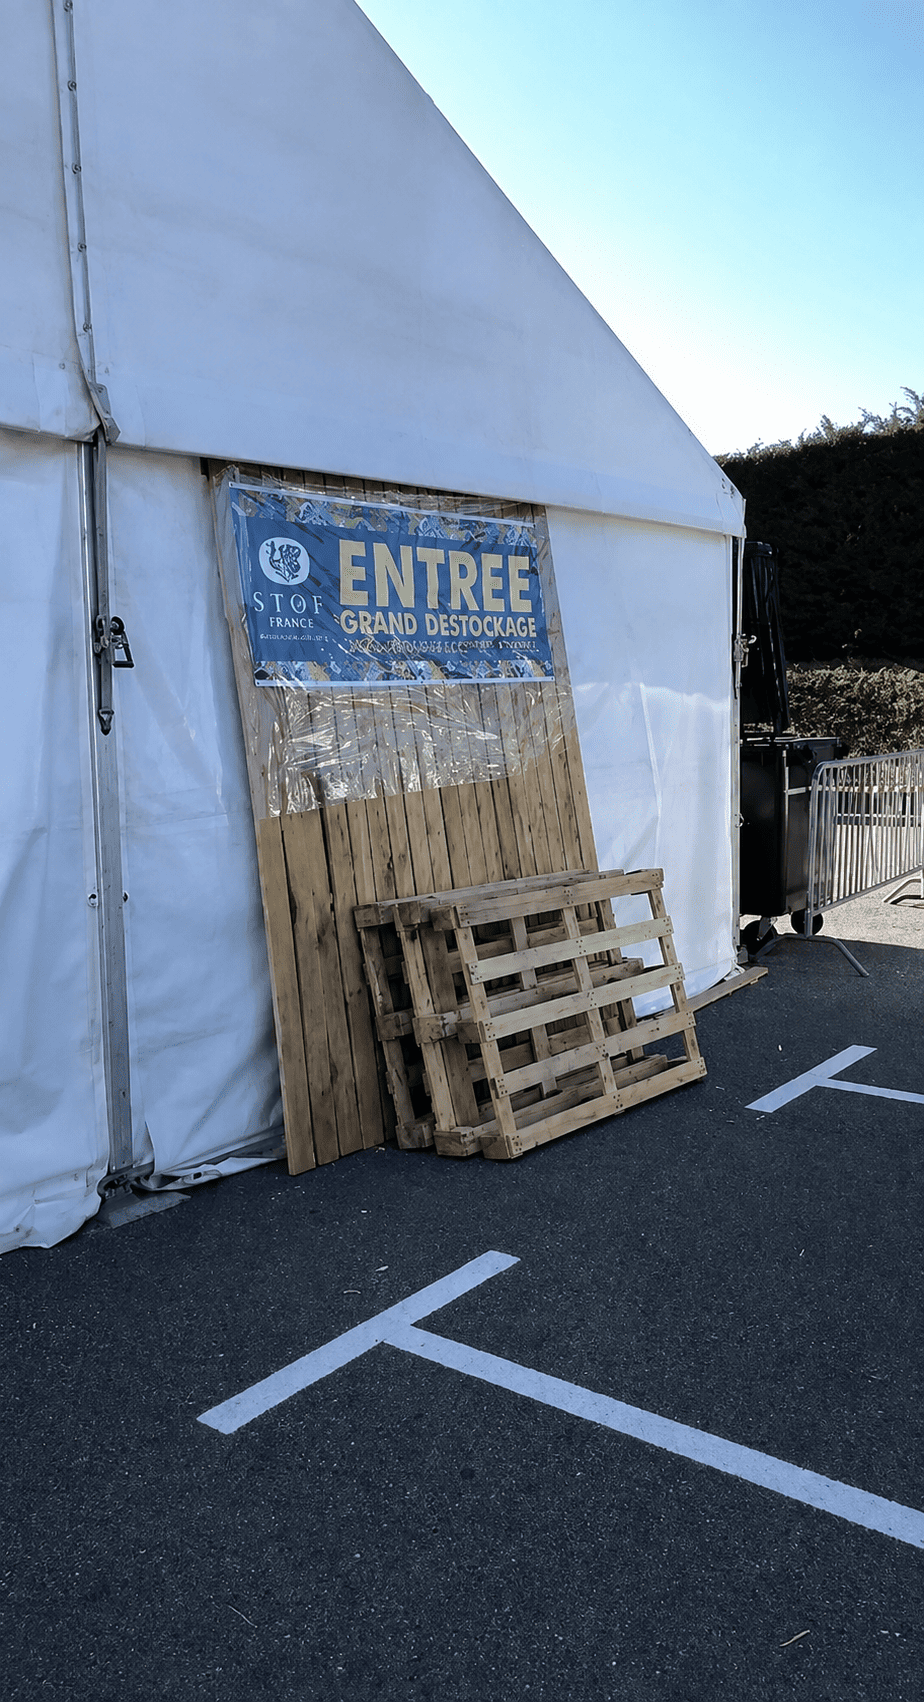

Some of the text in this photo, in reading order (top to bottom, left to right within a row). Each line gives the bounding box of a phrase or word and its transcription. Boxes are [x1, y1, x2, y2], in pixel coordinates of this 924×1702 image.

[339, 539, 532, 613] ENTREE
[253, 591, 323, 614] STOF
[269, 616, 314, 628] FRANCE
[340, 609, 537, 637] GRAND DESTOCKAGE
